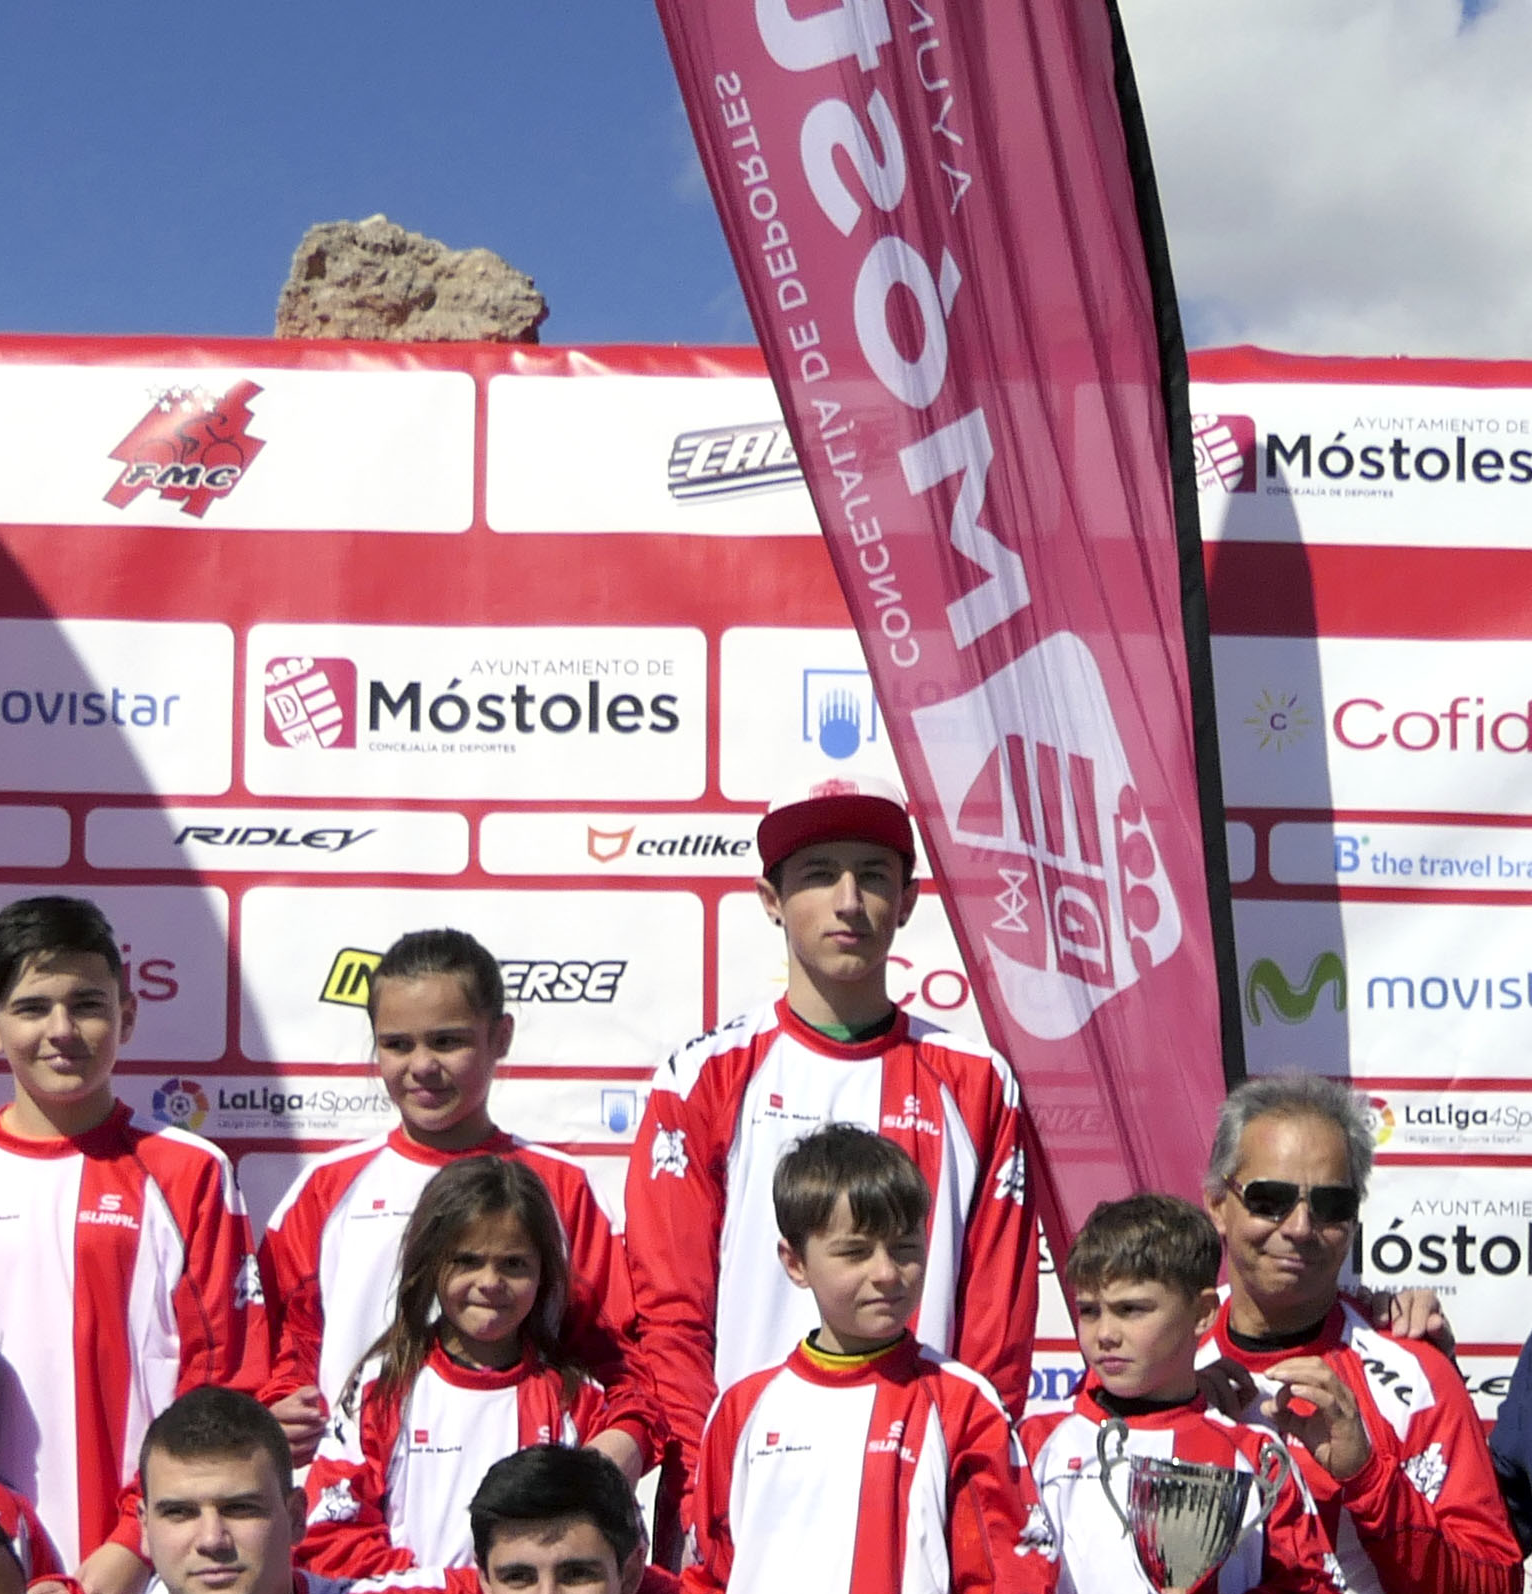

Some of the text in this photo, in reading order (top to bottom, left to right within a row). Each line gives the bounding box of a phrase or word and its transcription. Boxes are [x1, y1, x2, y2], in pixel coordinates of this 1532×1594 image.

[1354, 416, 1531, 435] AYUNTAMIENTO DE
[124, 462, 241, 490] FMC
[469, 658, 675, 676] AYUNTAMIENTO DE
[368, 677, 681, 735] Móstoles
[441, 742, 457, 754] DE
[458, 742, 517, 754] DEPORTES
[174, 825, 379, 854] RIDLEY
[636, 834, 752, 857] catlike
[1370, 851, 1414, 877] the
[1418, 852, 1492, 878] travel
